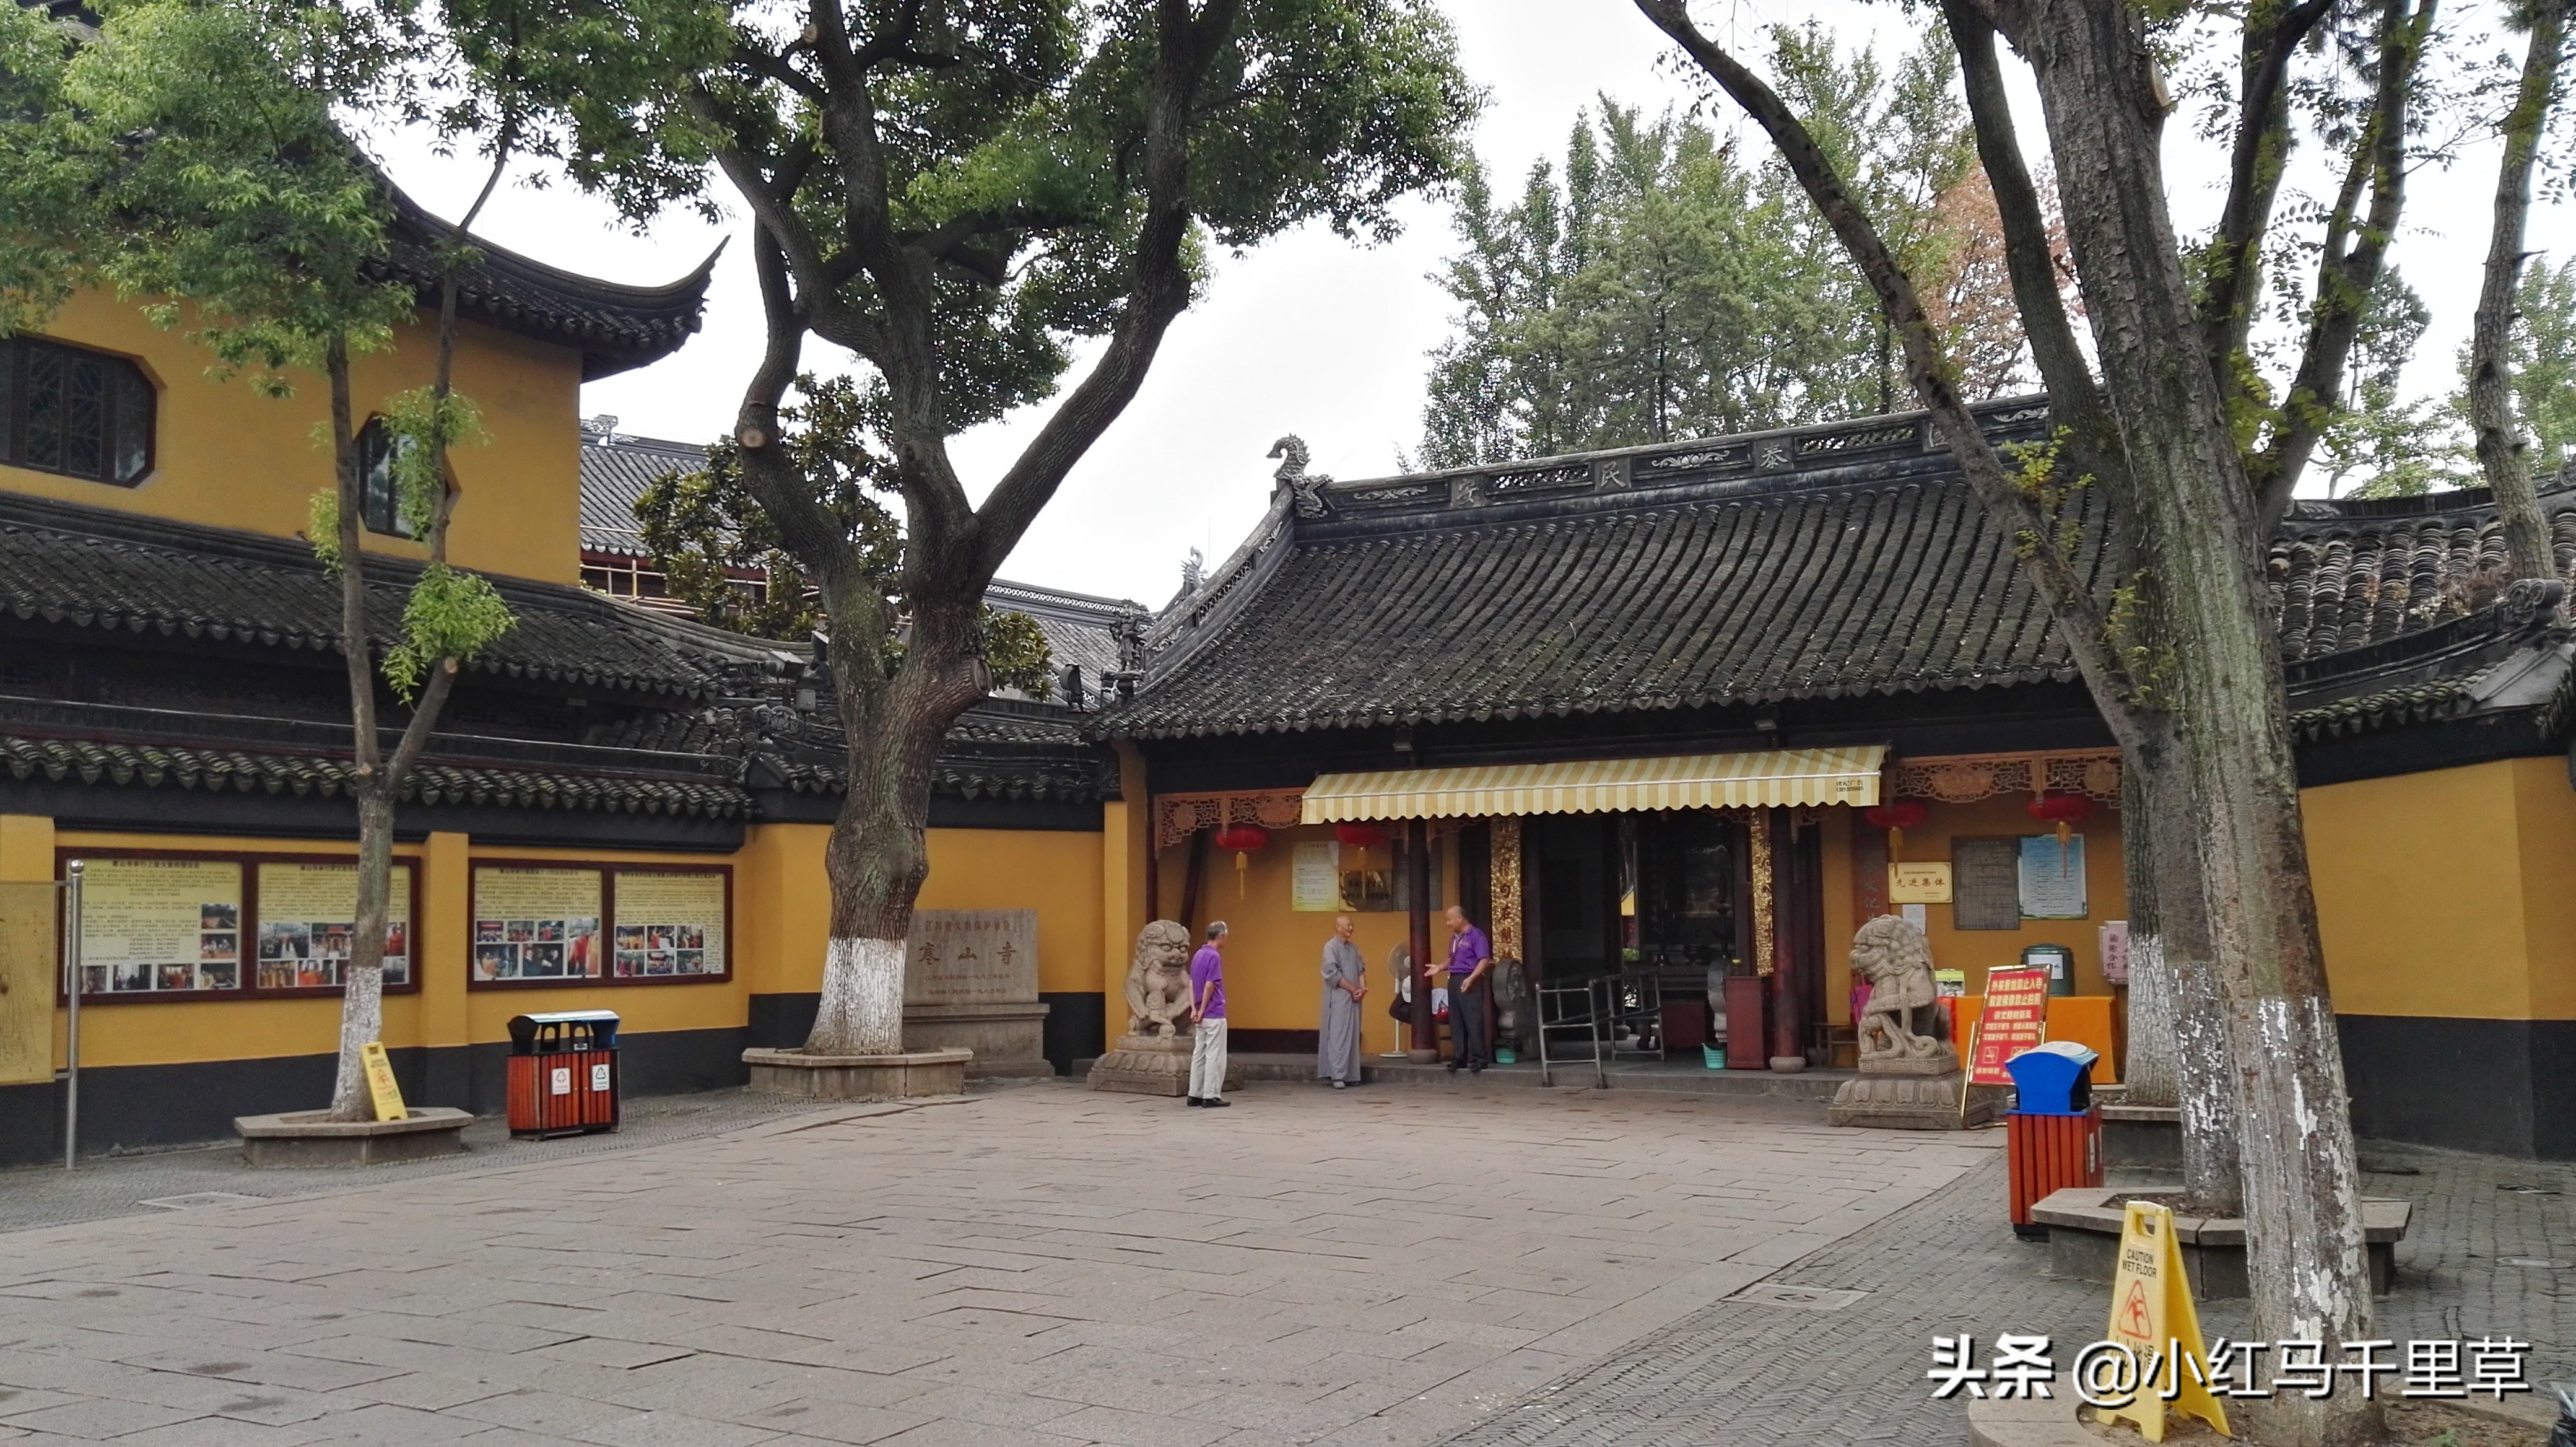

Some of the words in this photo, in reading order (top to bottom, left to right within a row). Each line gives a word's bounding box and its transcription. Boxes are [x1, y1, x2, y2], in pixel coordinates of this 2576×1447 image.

[1895, 877, 1945, 888] 先进集体
[918, 941, 1017, 966] 寒山寺
[2127, 1249, 2154, 1265] CAUTION
[2122, 1259, 2136, 1272] WET
[2136, 1263, 2157, 1279] FLOOR
